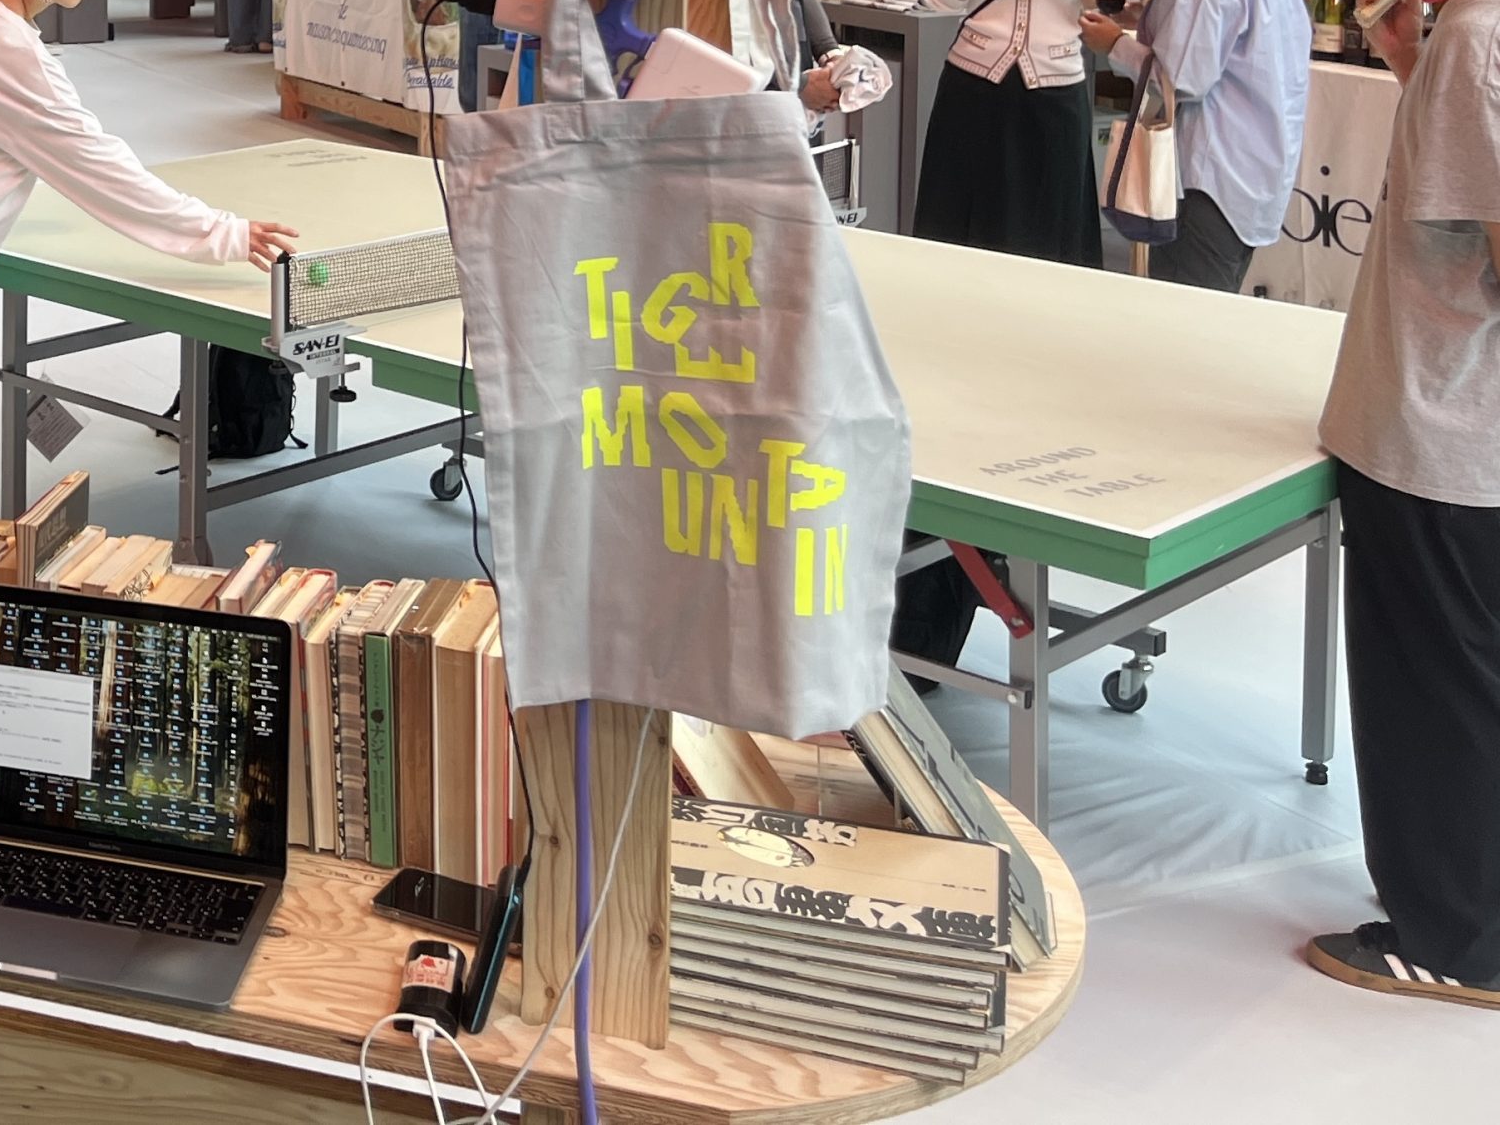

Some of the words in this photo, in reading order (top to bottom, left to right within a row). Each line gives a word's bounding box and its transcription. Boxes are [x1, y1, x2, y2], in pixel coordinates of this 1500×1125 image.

[574, 222, 760, 383] TIGER
[293, 334, 340, 355] SAN-EI
[979, 447, 1097, 475] AROUND
[1018, 470, 1088, 486] THE
[1064, 474, 1166, 497] TABLE
[581, 385, 847, 616] MOUNTAIN
